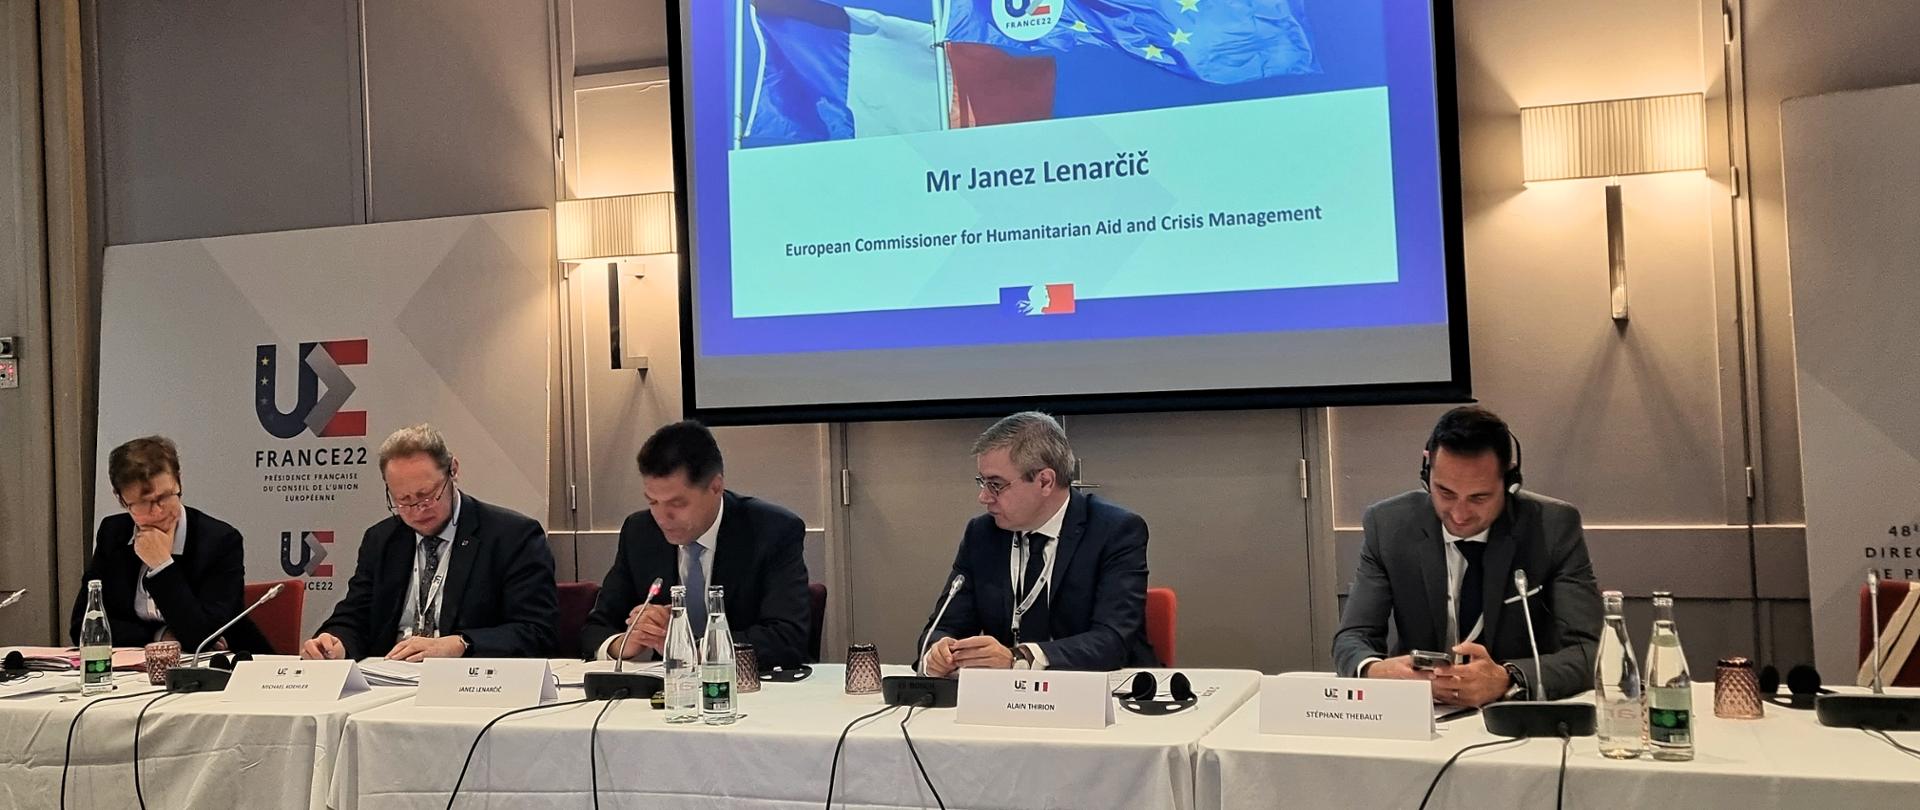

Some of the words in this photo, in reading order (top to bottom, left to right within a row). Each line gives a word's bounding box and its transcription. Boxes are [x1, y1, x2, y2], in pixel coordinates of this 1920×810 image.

[1006, 18, 1051, 29] FRANCE22
[926, 169, 961, 193] Mr
[968, 166, 1036, 190] Janez
[1043, 150, 1150, 183] Lenarčič
[785, 239, 851, 258] European
[855, 231, 957, 252] Commissioner
[961, 229, 982, 245] for
[986, 222, 1092, 242] Humanitarian
[1095, 218, 1122, 235] Aid
[1127, 216, 1156, 233] and
[1161, 213, 1204, 231] Crisis
[1208, 204, 1322, 227] Management
[255, 446, 367, 468] FRANCE22
[264, 473, 311, 482] PRÉSIDENCE
[314, 472, 358, 482] FRANÇAISE
[285, 494, 335, 502] EUROPÉENNE
[1006, 702, 1025, 710] ALAIN
[1028, 703, 1055, 711] THIRION
[1306, 710, 1344, 719] STÉPHANE
[1346, 712, 1383, 721] THEBAULT
